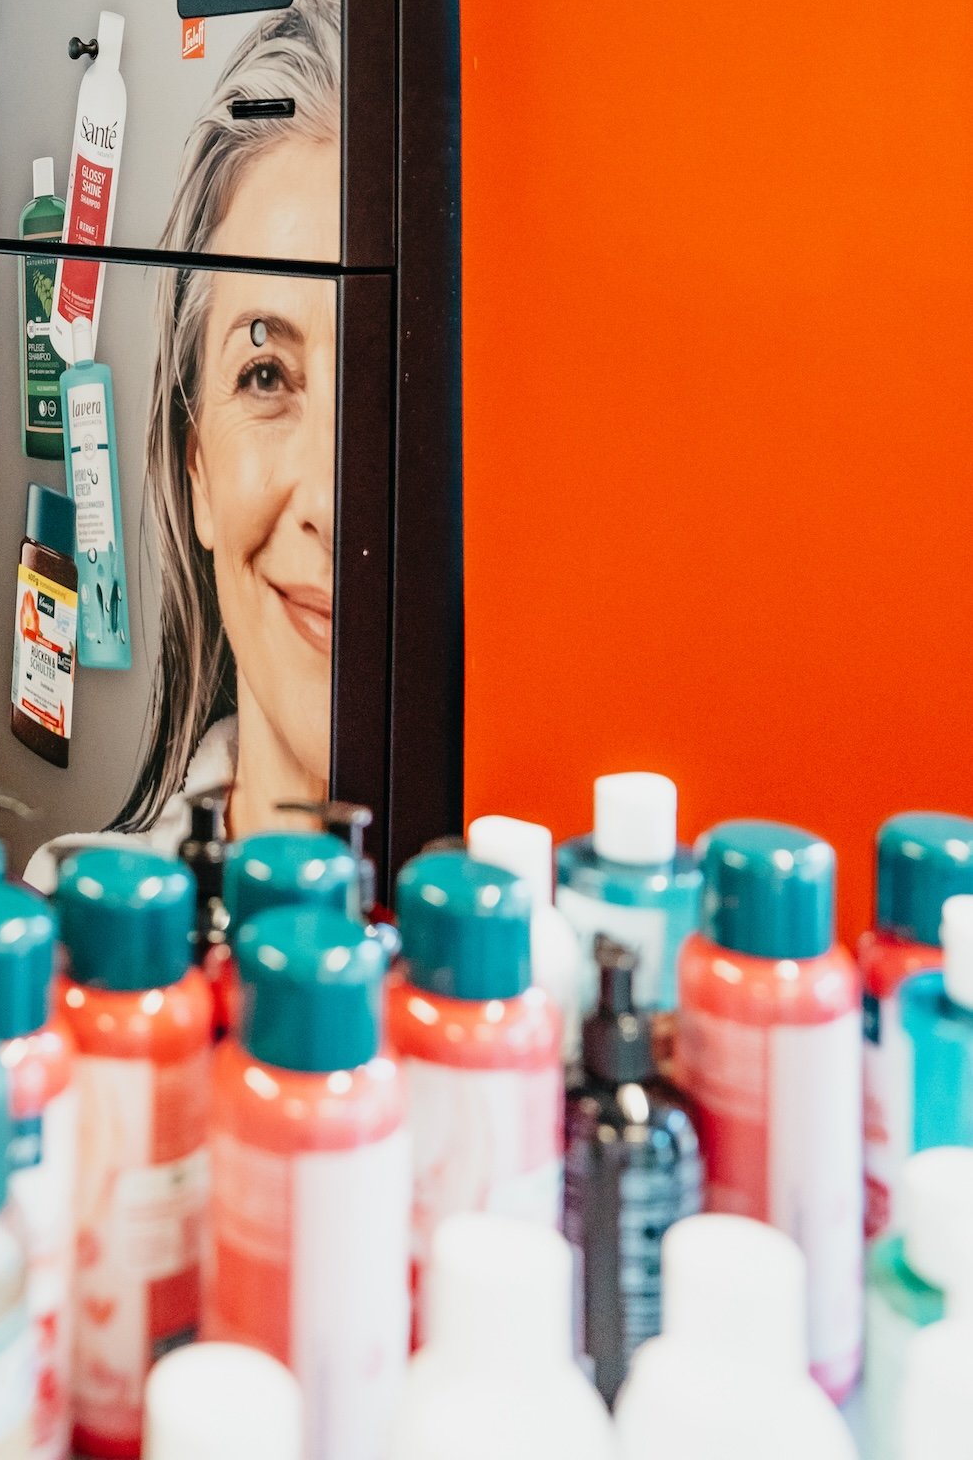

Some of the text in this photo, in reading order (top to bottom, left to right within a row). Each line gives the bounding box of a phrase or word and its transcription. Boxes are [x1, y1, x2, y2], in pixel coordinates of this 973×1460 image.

[80, 115, 118, 149] Santé
[81, 164, 106, 185] GLOSSY
[81, 180, 102, 198] SHINE
[80, 194, 101, 210] SHAMPOO
[28, 352, 51, 361] SHAMPOO
[72, 399, 101, 419] lavera
[30, 645, 51, 667] RÜCKEN
[30, 657, 56, 680] SCHULTER
